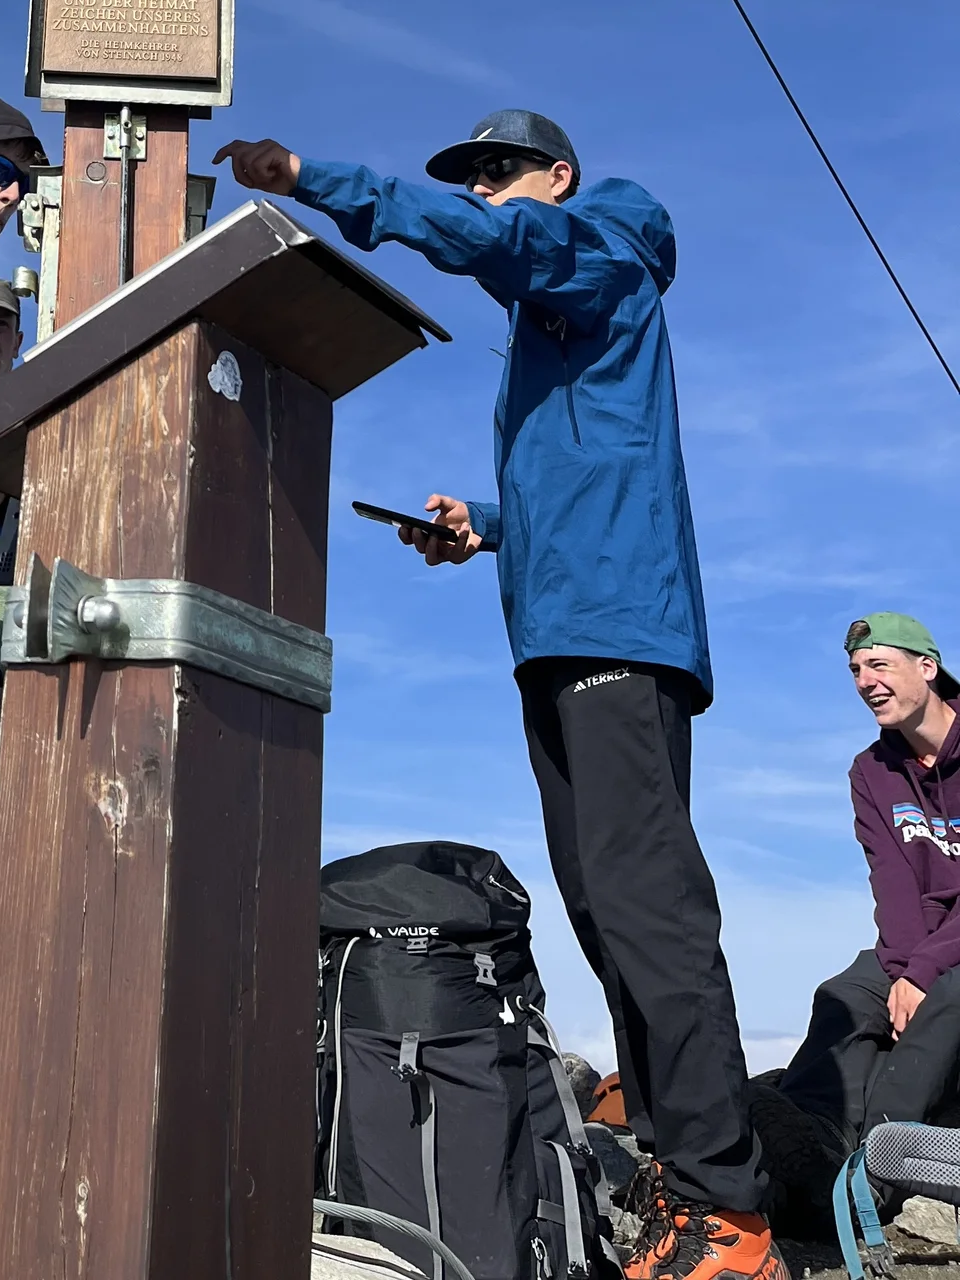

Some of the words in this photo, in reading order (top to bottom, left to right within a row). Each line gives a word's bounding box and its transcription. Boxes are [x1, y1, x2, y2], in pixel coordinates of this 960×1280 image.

[60, 7, 127, 21] ZEICHEN
[133, 10, 201, 23] UNSERES
[52, 20, 209, 36] ZUSAMMENHALTENS
[81, 39, 100, 49] DIE
[105, 40, 179, 52] HEIMKEHRER
[75, 49, 100, 59] VON
[102, 50, 159, 61] STEINACH
[161, 53, 183, 62] 1948
[585, 667, 630, 687] TERREX
[387, 926, 439, 936] VAUDE
